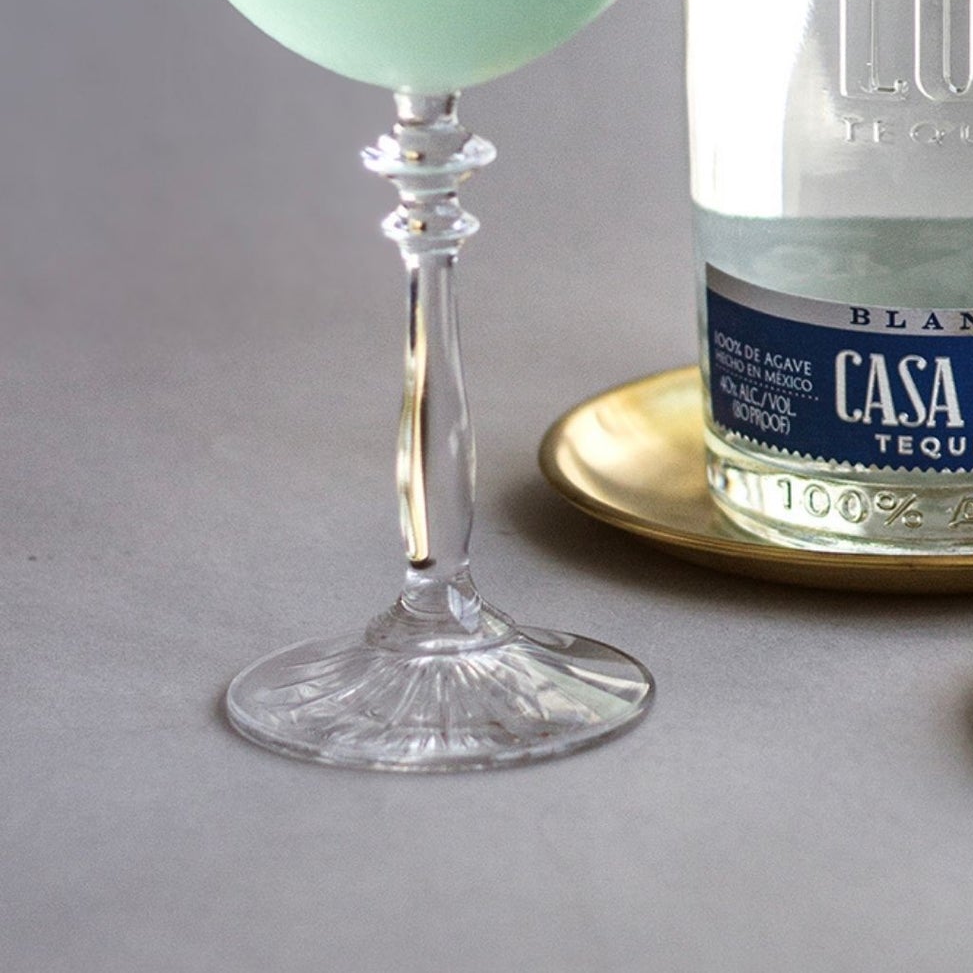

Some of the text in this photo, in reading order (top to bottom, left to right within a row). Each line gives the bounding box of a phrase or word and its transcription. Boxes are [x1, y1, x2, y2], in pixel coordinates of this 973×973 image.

[714, 330, 812, 376] 100% DE AGAVE
[747, 363, 761, 379] EN
[834, 349, 965, 428] CASA
[777, 477, 924, 529] 100%
